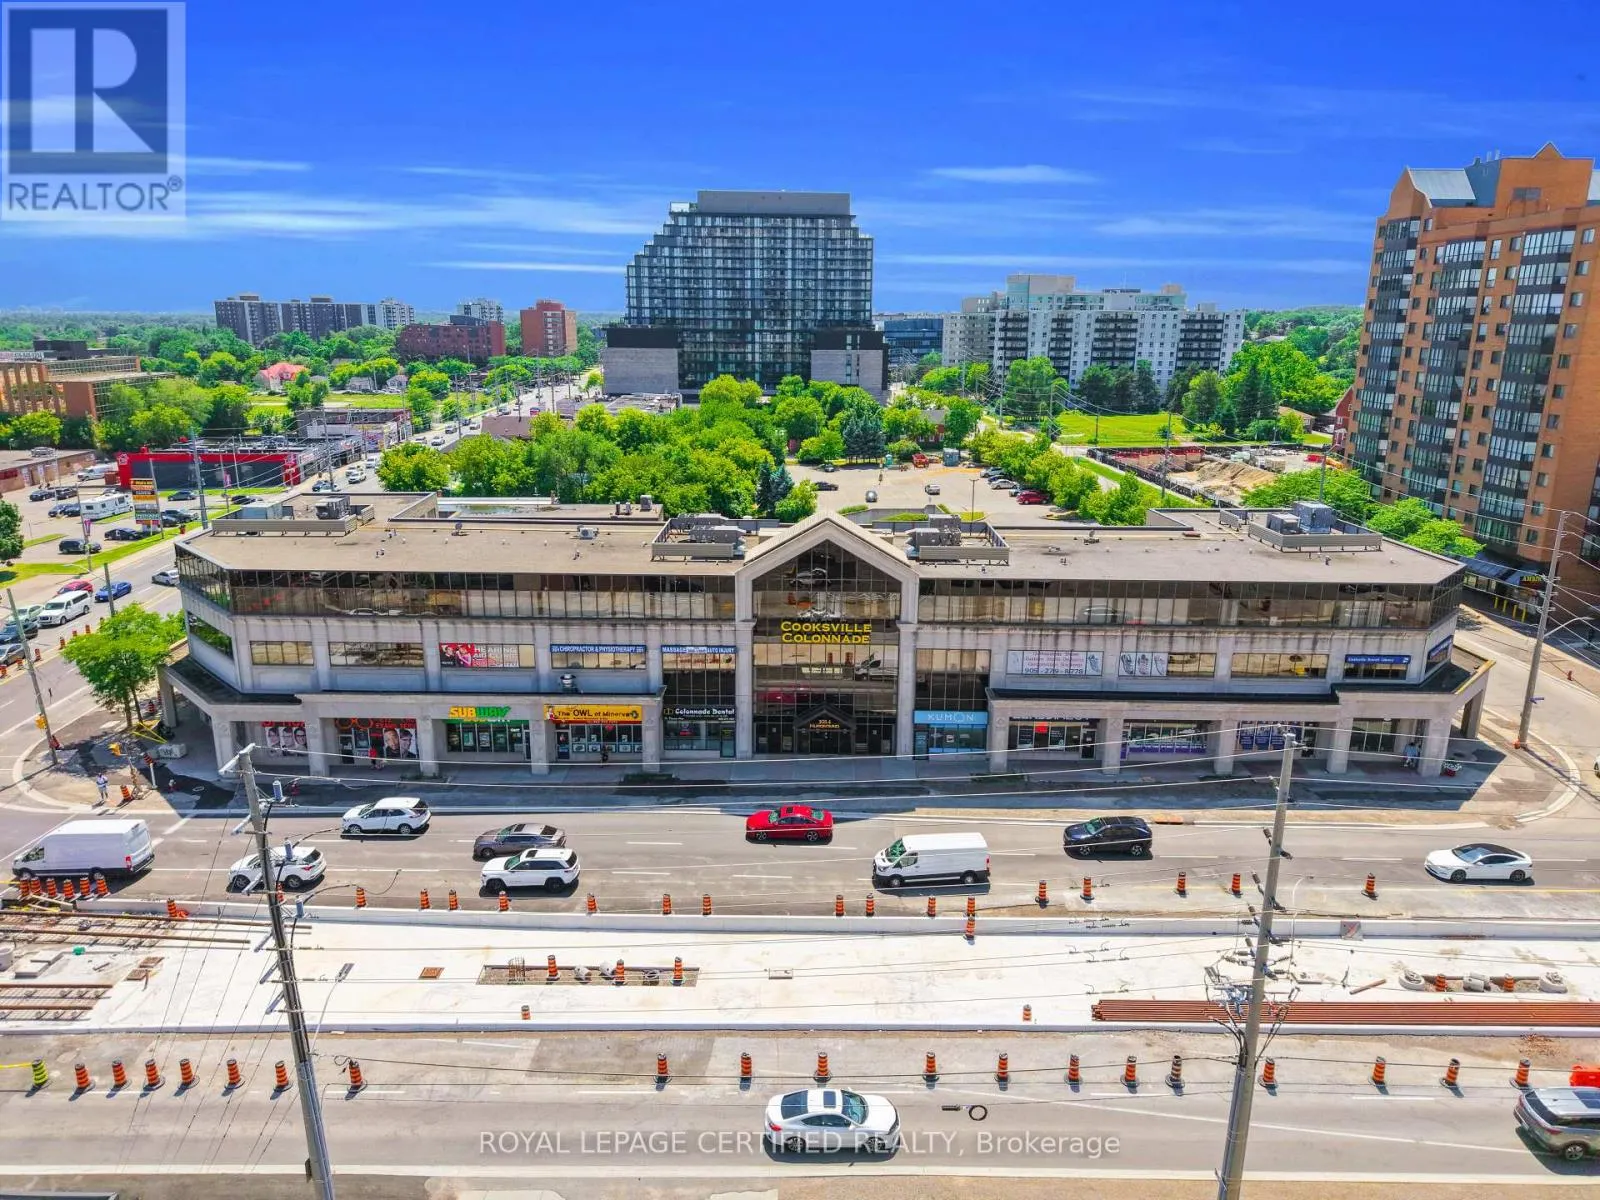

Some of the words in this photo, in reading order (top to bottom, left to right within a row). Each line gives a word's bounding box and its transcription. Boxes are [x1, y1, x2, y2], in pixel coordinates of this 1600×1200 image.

[781, 621, 872, 633] COOKSVILLE
[782, 633, 870, 644] COLONNADE
[560, 645, 594, 653] CHIROPRACTOR
[447, 706, 511, 719] SUBWAY
[573, 709, 592, 717] OWL
[927, 712, 974, 723] KUMON
